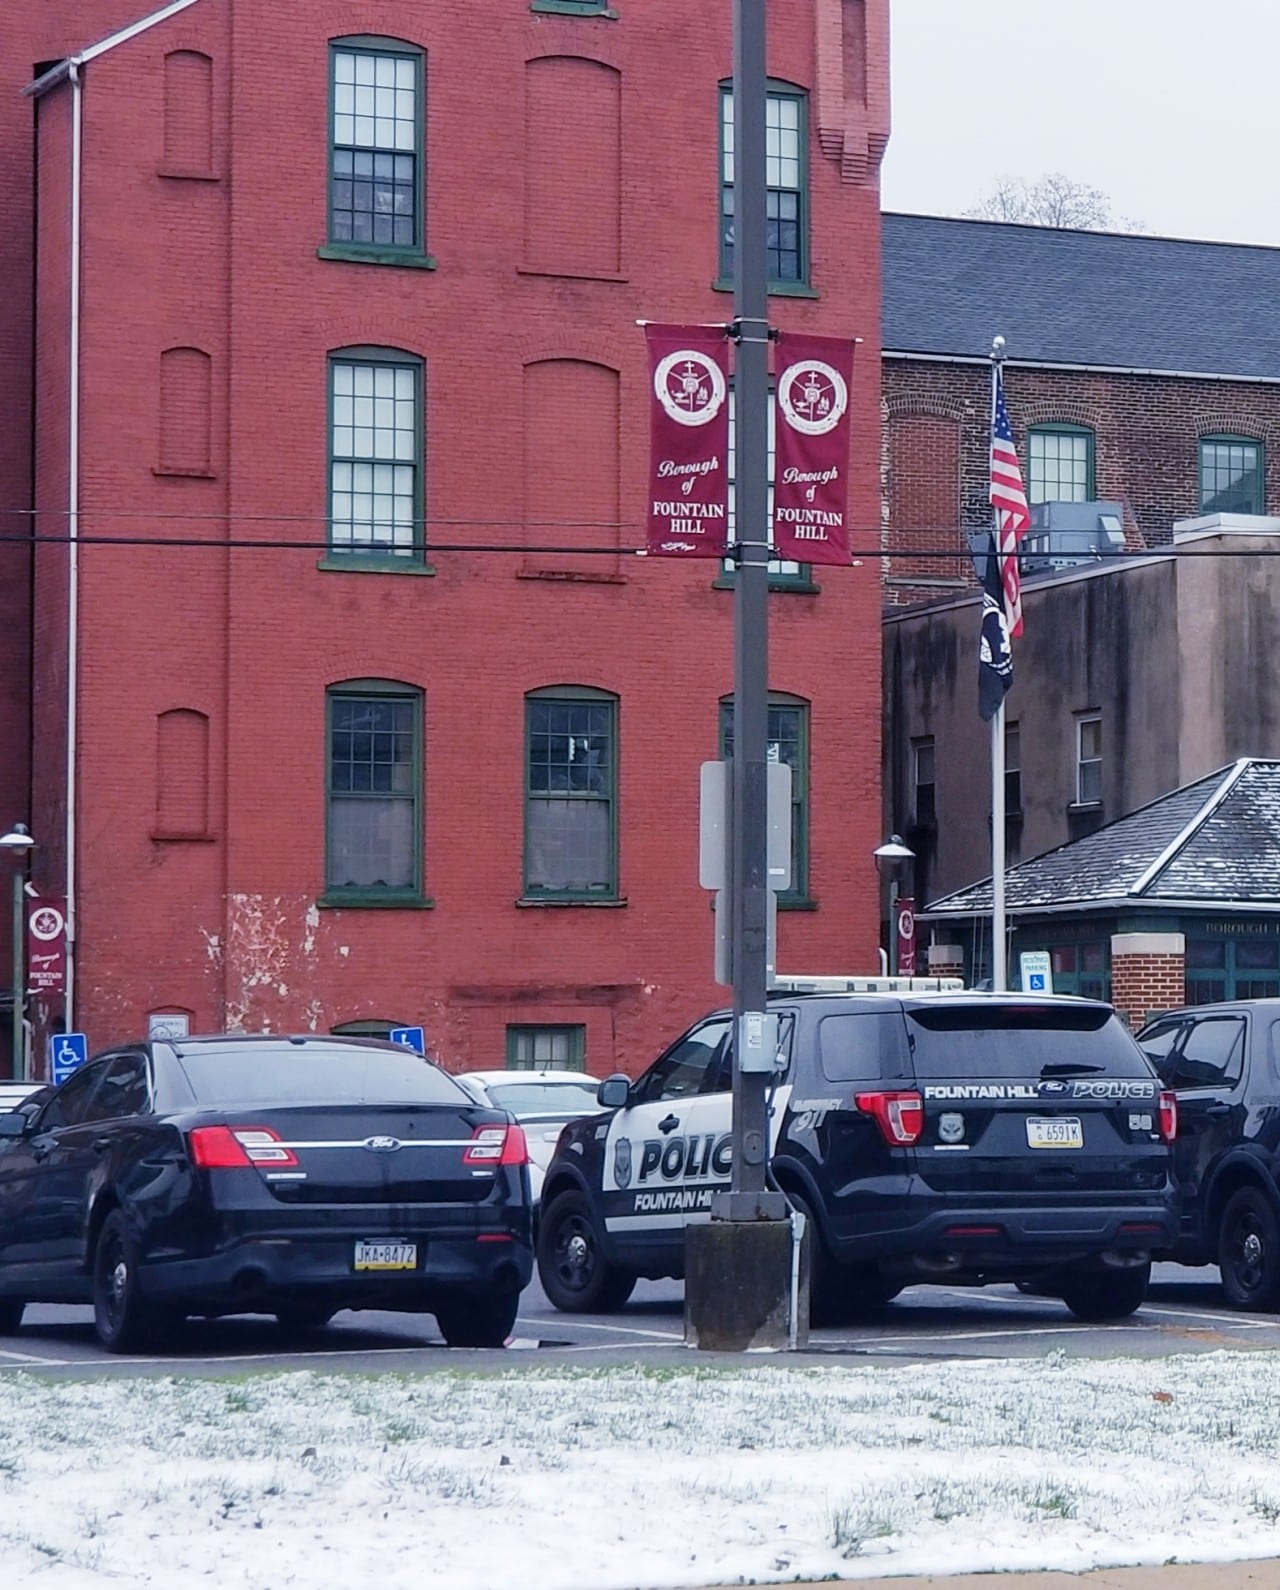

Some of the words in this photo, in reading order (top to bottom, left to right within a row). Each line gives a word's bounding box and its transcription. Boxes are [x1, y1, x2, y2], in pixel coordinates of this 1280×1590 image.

[658, 456, 719, 477] Borough
[782, 466, 839, 485] Borough
[681, 476, 696, 495] of
[805, 485, 817, 502] of
[653, 501, 724, 518] FOUNTAIN
[776, 507, 843, 526] FOUNTAIN
[670, 518, 705, 534] HILL
[794, 525, 828, 541] HILL
[1206, 922, 1269, 936] BOROUGH
[925, 1085, 1005, 1100] FOUNTAIN
[1007, 1085, 1039, 1099] HILL
[1073, 1081, 1155, 1099] POLICE
[637, 1133, 732, 1184] POLIC
[634, 1190, 696, 1211] FOUNTAIN
